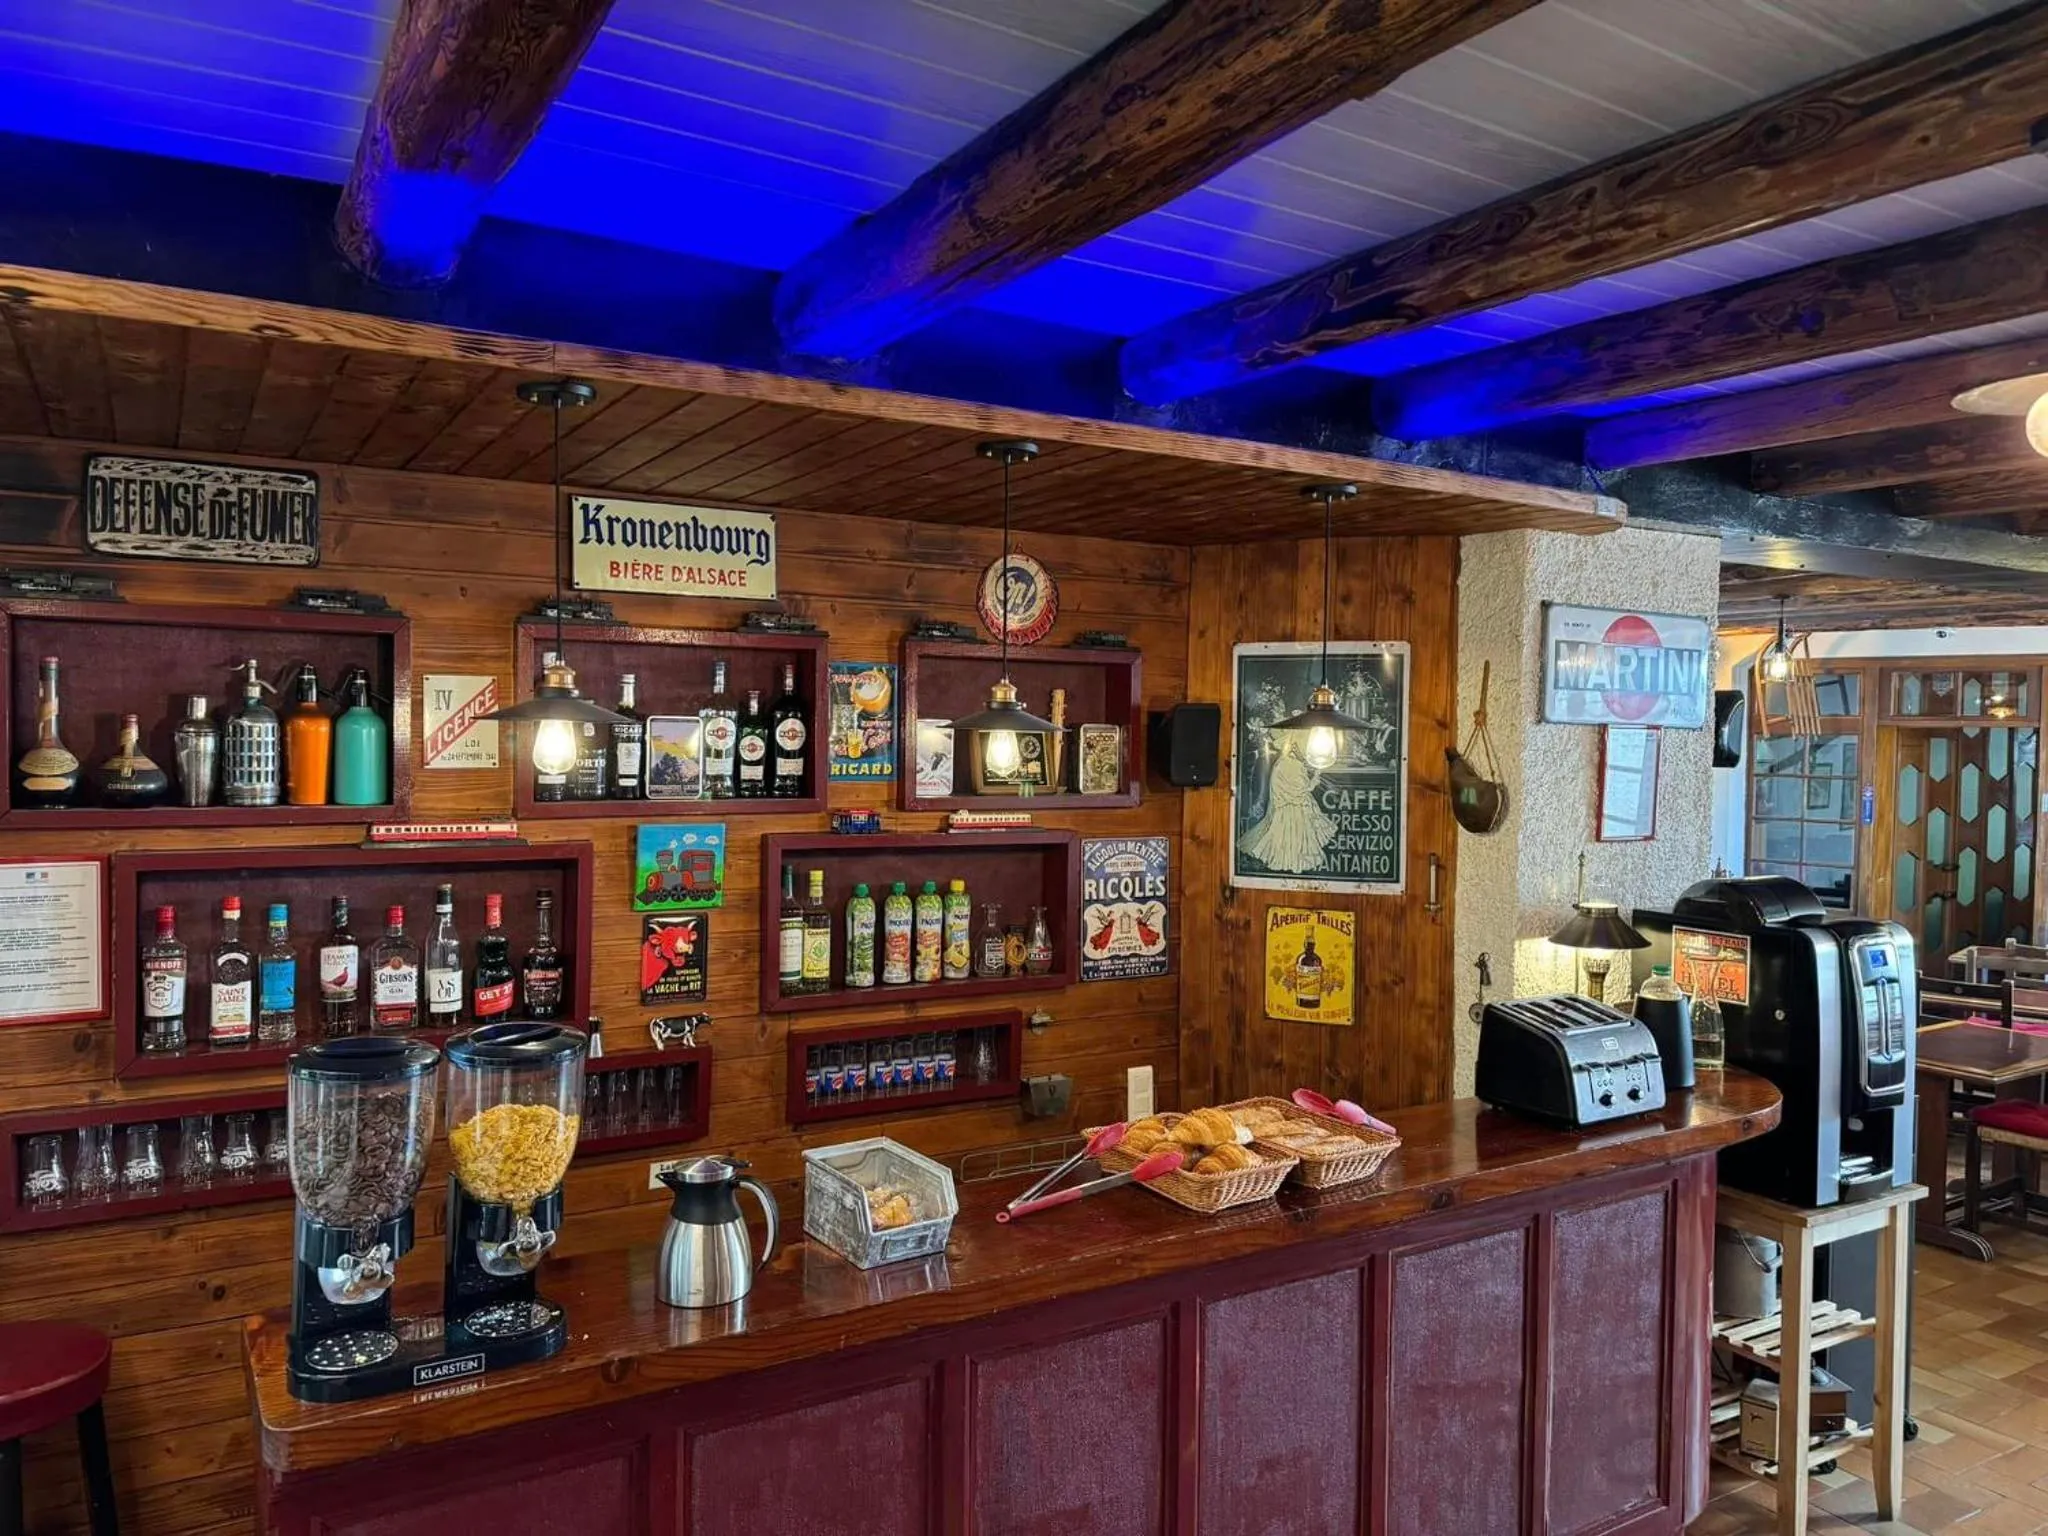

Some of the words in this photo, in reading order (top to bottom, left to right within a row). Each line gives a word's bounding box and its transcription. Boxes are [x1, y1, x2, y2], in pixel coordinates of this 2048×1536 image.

[90, 476, 207, 537] DEFENSE
[208, 499, 238, 540] DE
[238, 488, 317, 546] FUMER
[579, 503, 770, 566] Kronenbourg
[609, 559, 664, 581] BIÈRE
[671, 565, 747, 587] D'ALSACE
[1557, 642, 1701, 695] MARTINI
[434, 689, 453, 710] IV
[427, 685, 495, 762] LICENCE
[831, 763, 893, 776] RICARD
[1323, 813, 1392, 832] PRESSO
[1328, 834, 1394, 851] SERVIZIO
[1313, 854, 1390, 875] ANTANEO
[478, 989, 501, 1001] GET
[419, 1358, 478, 1380] KLARSTEIN
